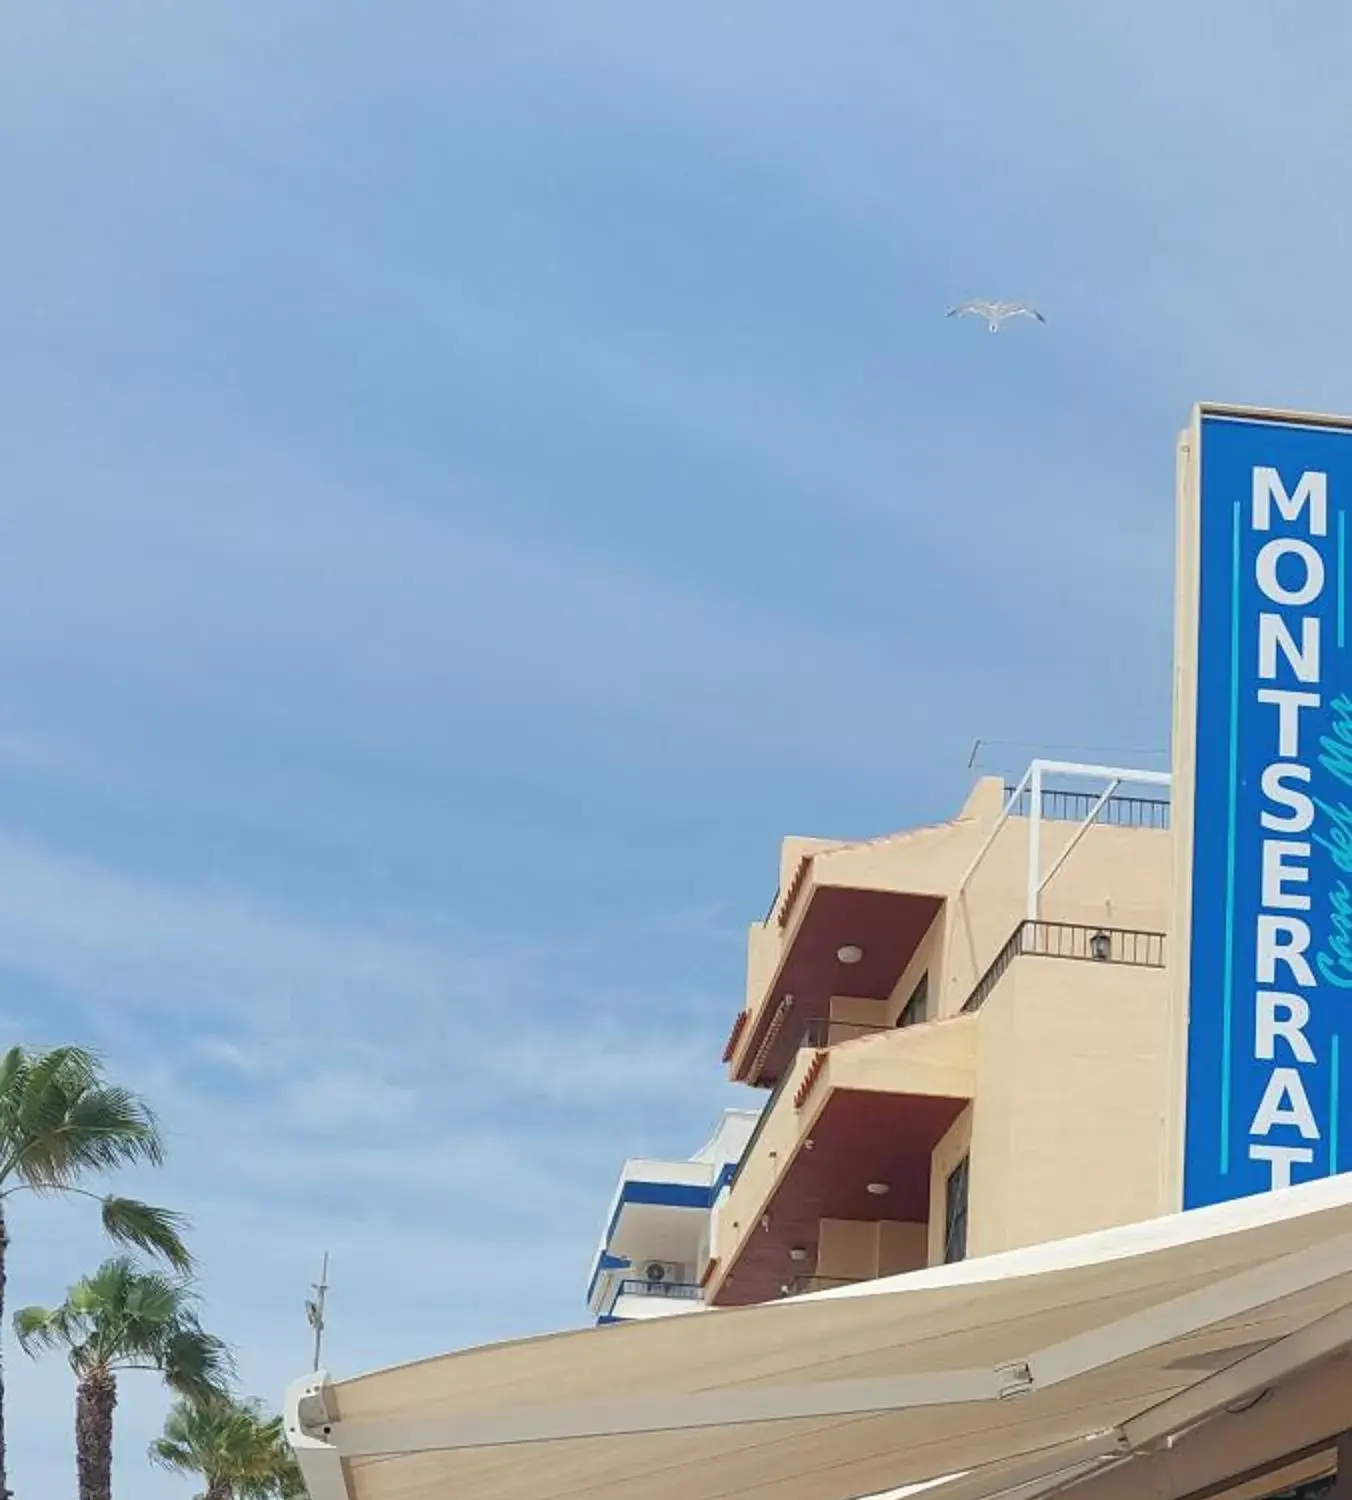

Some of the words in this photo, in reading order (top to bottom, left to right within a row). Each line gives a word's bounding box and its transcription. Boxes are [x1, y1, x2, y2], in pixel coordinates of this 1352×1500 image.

[1317, 693, 1352, 786] Mar
[1249, 466, 1326, 1191] MONTSERRAT
[1312, 797, 1352, 873] del
[1316, 880, 1352, 988] Casa
